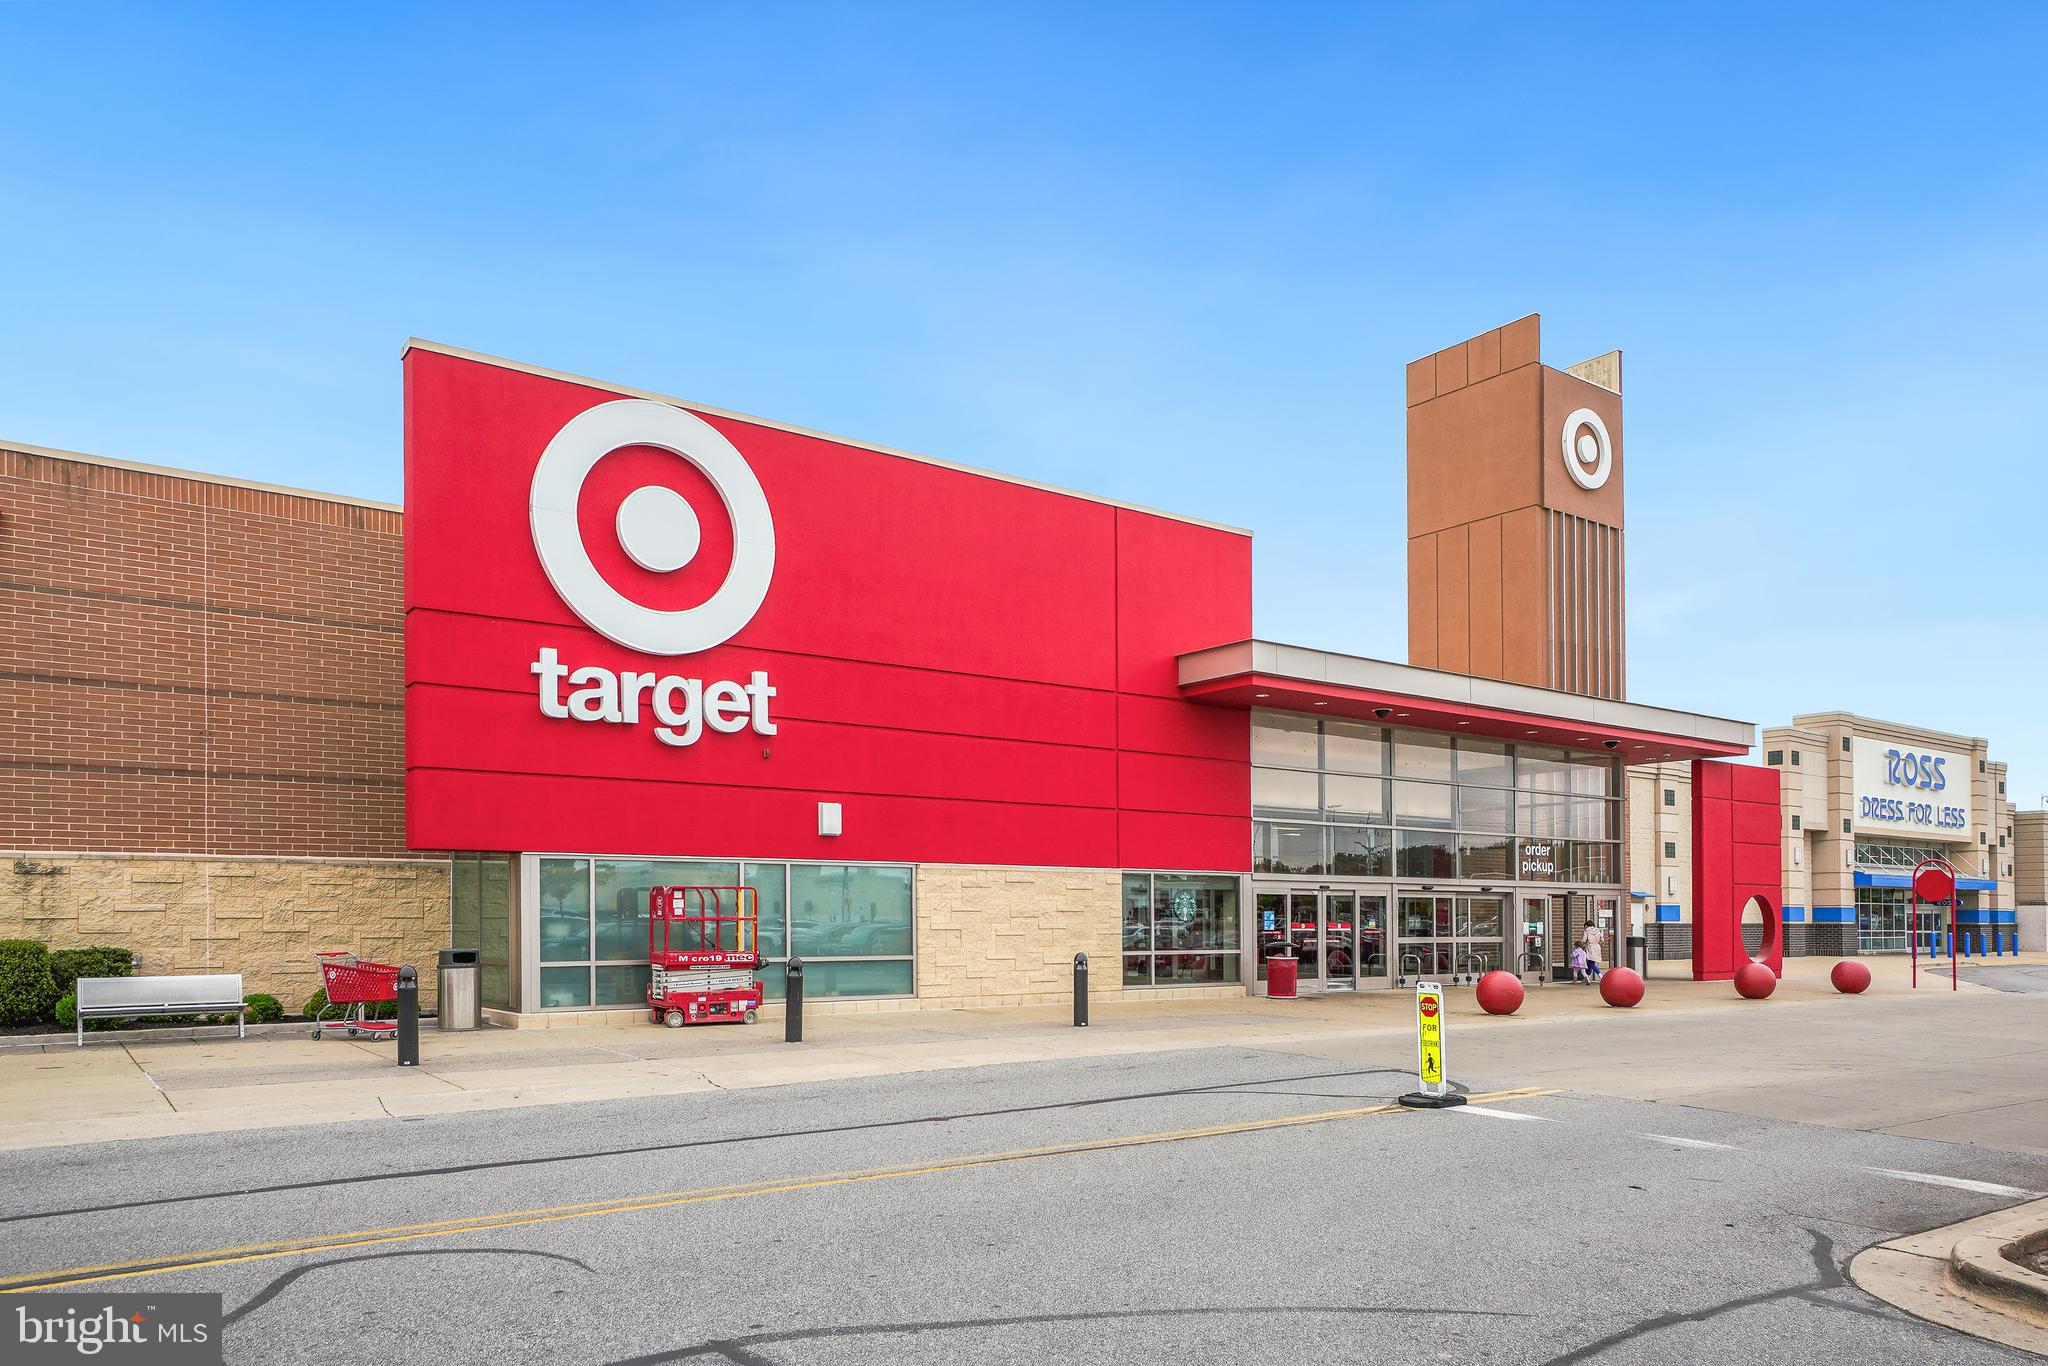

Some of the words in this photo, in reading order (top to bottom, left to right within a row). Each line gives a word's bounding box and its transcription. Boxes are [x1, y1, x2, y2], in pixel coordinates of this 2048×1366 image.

[530, 646, 778, 747] target
[1886, 749, 1946, 791] ROSS
[1862, 796, 1905, 821] DRESS
[1908, 802, 1932, 825] FOR
[1937, 805, 1966, 828] LESS
[1525, 843, 1551, 856] order
[1522, 858, 1554, 875] pickup
[1421, 1003, 1437, 1011] STOP
[1422, 1023, 1437, 1032] FOR
